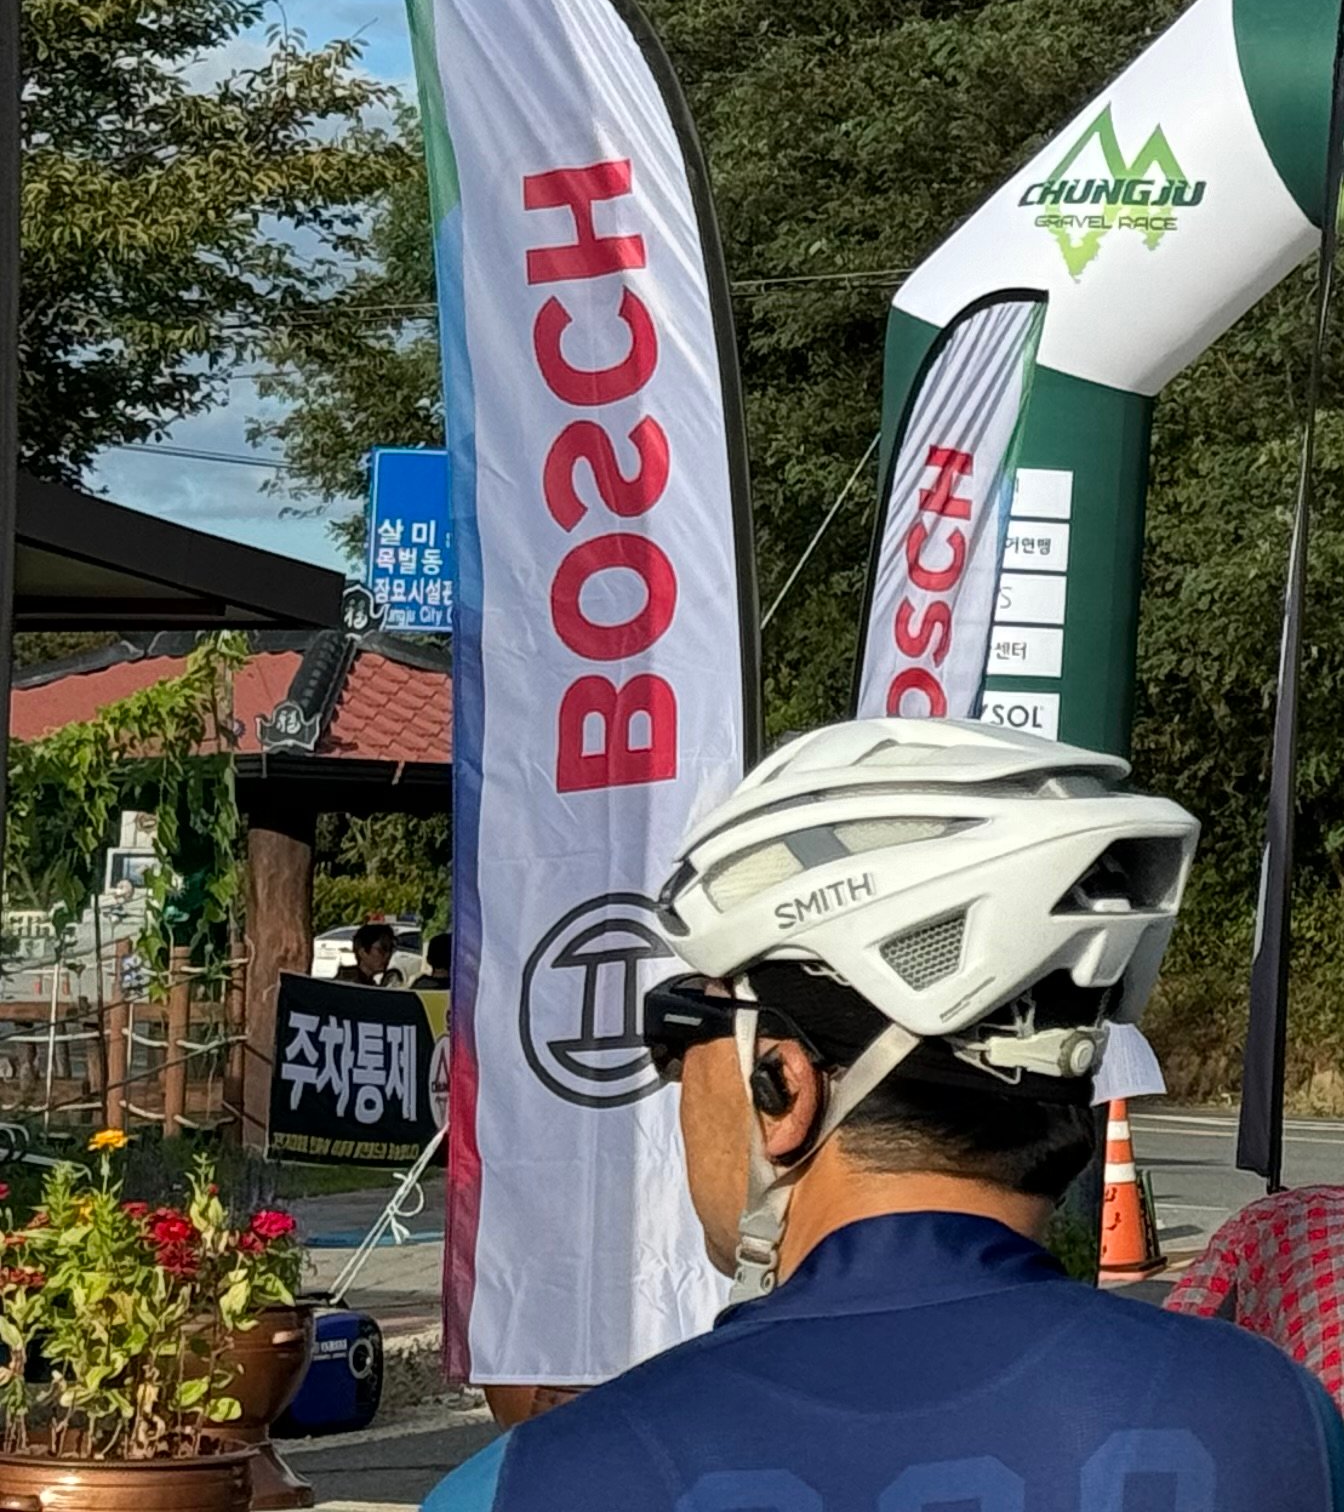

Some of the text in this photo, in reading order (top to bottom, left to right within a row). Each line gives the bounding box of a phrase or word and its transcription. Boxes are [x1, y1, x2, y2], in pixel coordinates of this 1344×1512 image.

[1017, 178, 1207, 208] CHUNGJU
[1034, 215, 1178, 231] GRAVEL RACE
[886, 443, 974, 719] OSCH
[773, 871, 875, 931] SMITH
[280, 1010, 418, 1125] 주차통제
